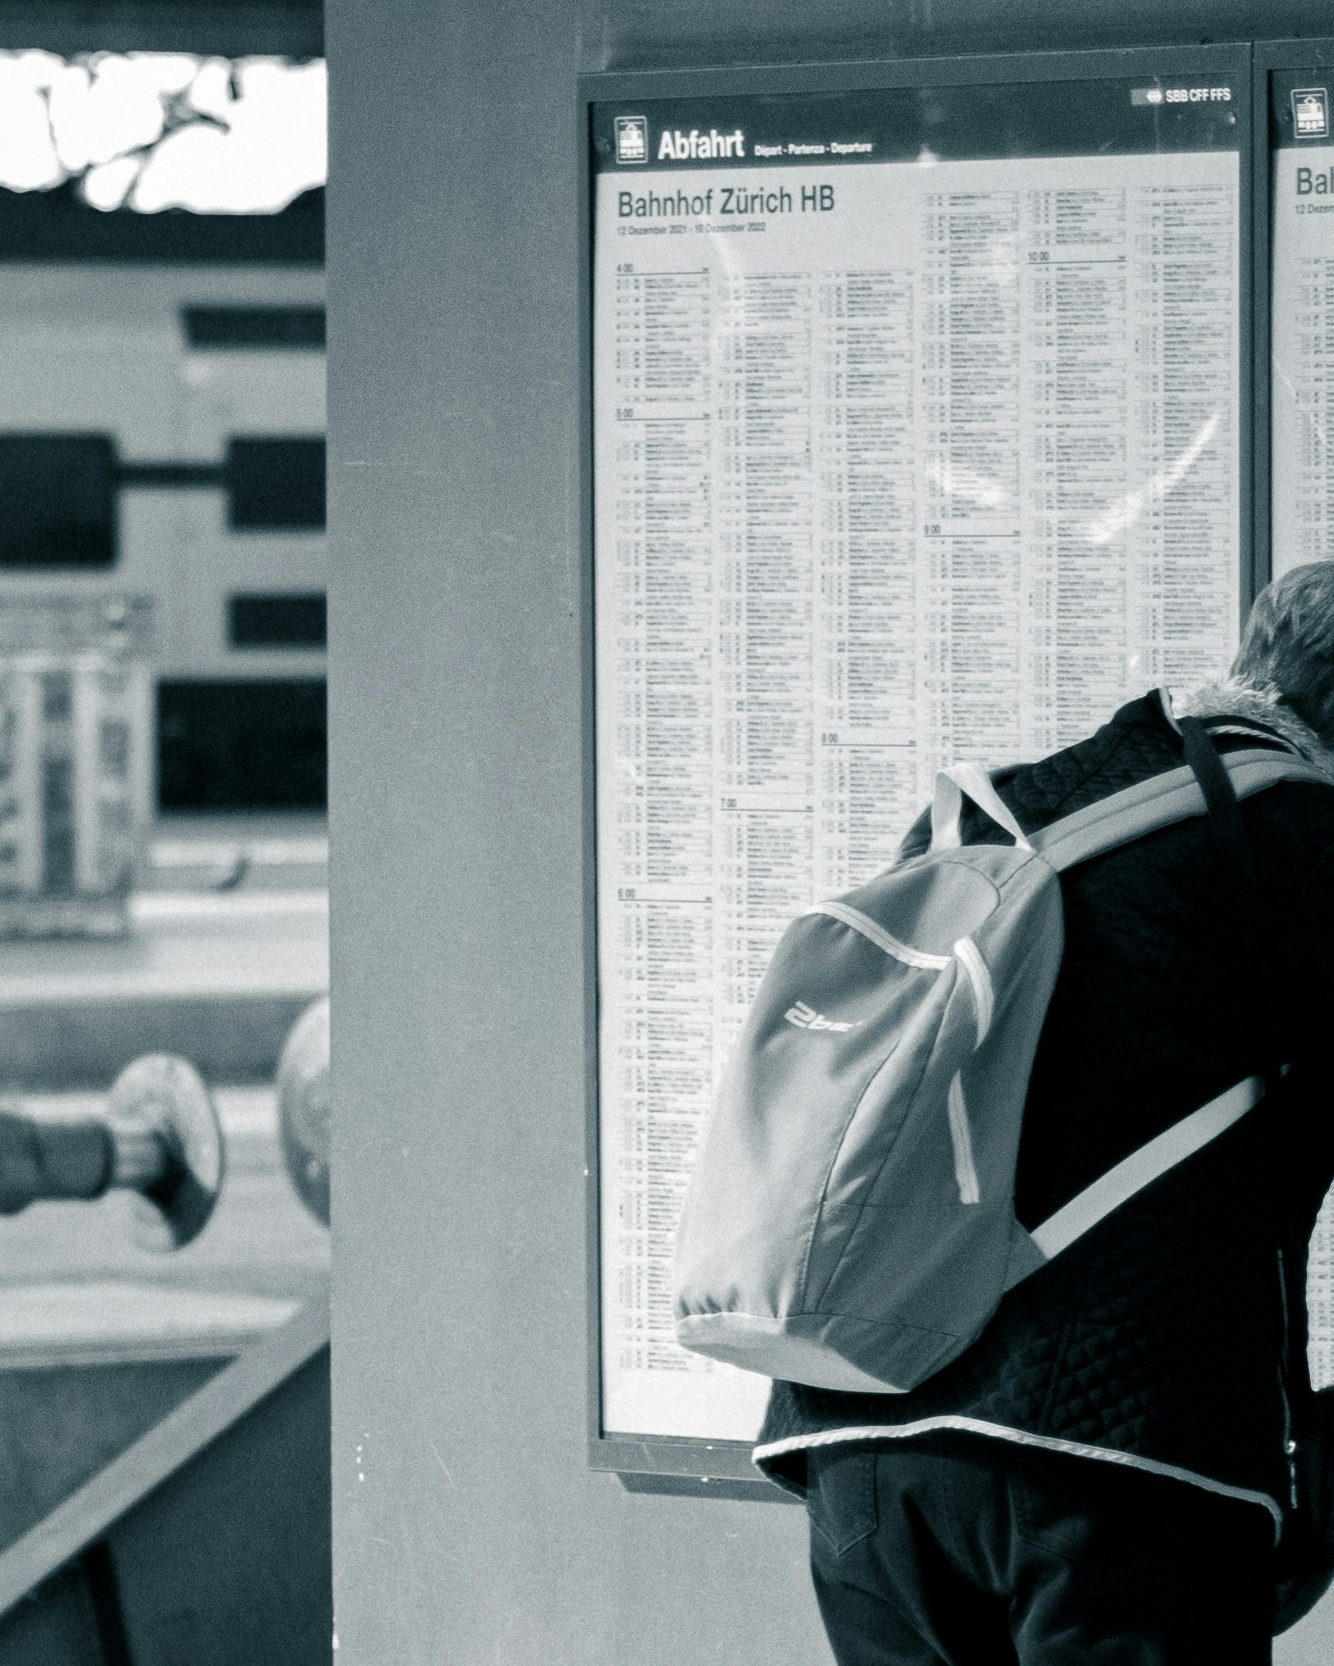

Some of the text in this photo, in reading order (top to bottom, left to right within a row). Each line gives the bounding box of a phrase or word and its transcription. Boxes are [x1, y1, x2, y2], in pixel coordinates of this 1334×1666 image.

[1166, 87, 1232, 103] SBB CFF FFS
[657, 129, 745, 160] Abfahrt
[618, 184, 835, 218] Bahnhof Zürich HB
